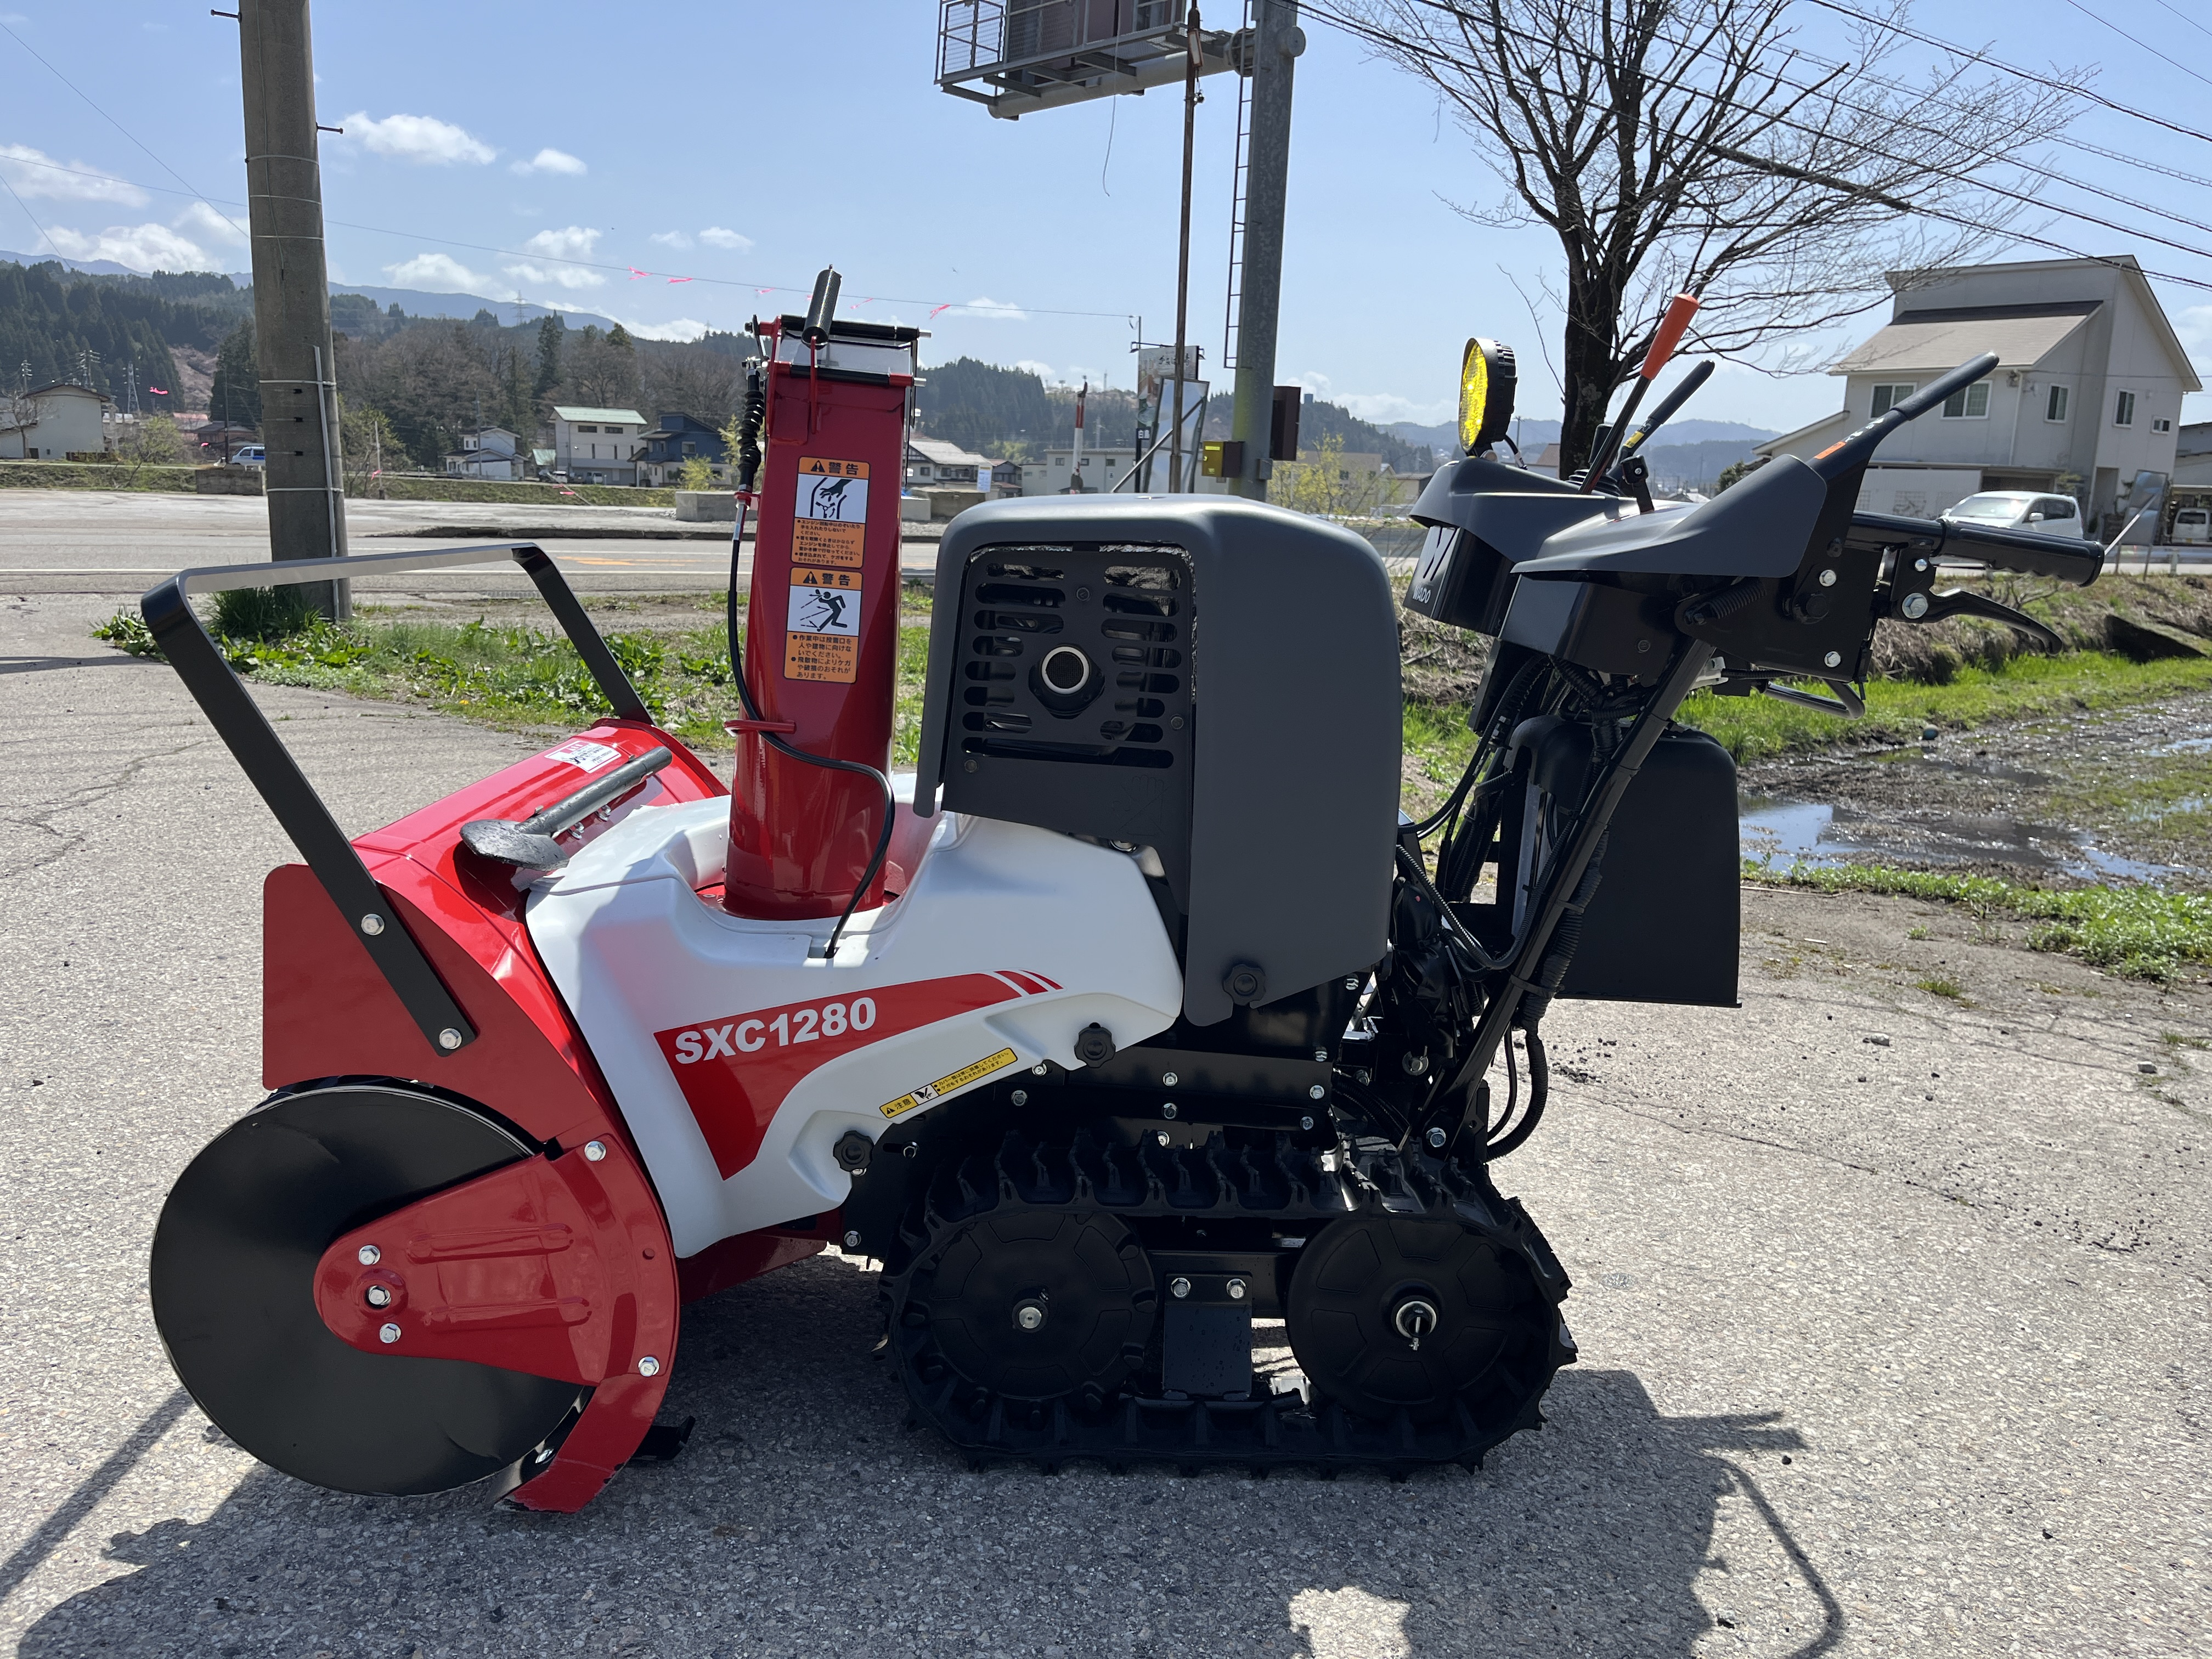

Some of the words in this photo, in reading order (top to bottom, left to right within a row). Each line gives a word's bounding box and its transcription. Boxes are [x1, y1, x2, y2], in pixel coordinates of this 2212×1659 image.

[829, 461, 859, 476] 警告
[822, 573, 850, 586] 警告
[1412, 585, 1431, 604] WADO
[799, 642, 851, 652] 人や建物に向けな
[798, 650, 841, 659] いでください。
[798, 657, 851, 666] 飛散物によりケガ
[797, 672, 827, 680] あります。
[675, 997, 876, 1065] SXC1280
[894, 1098, 912, 1110] 注意
